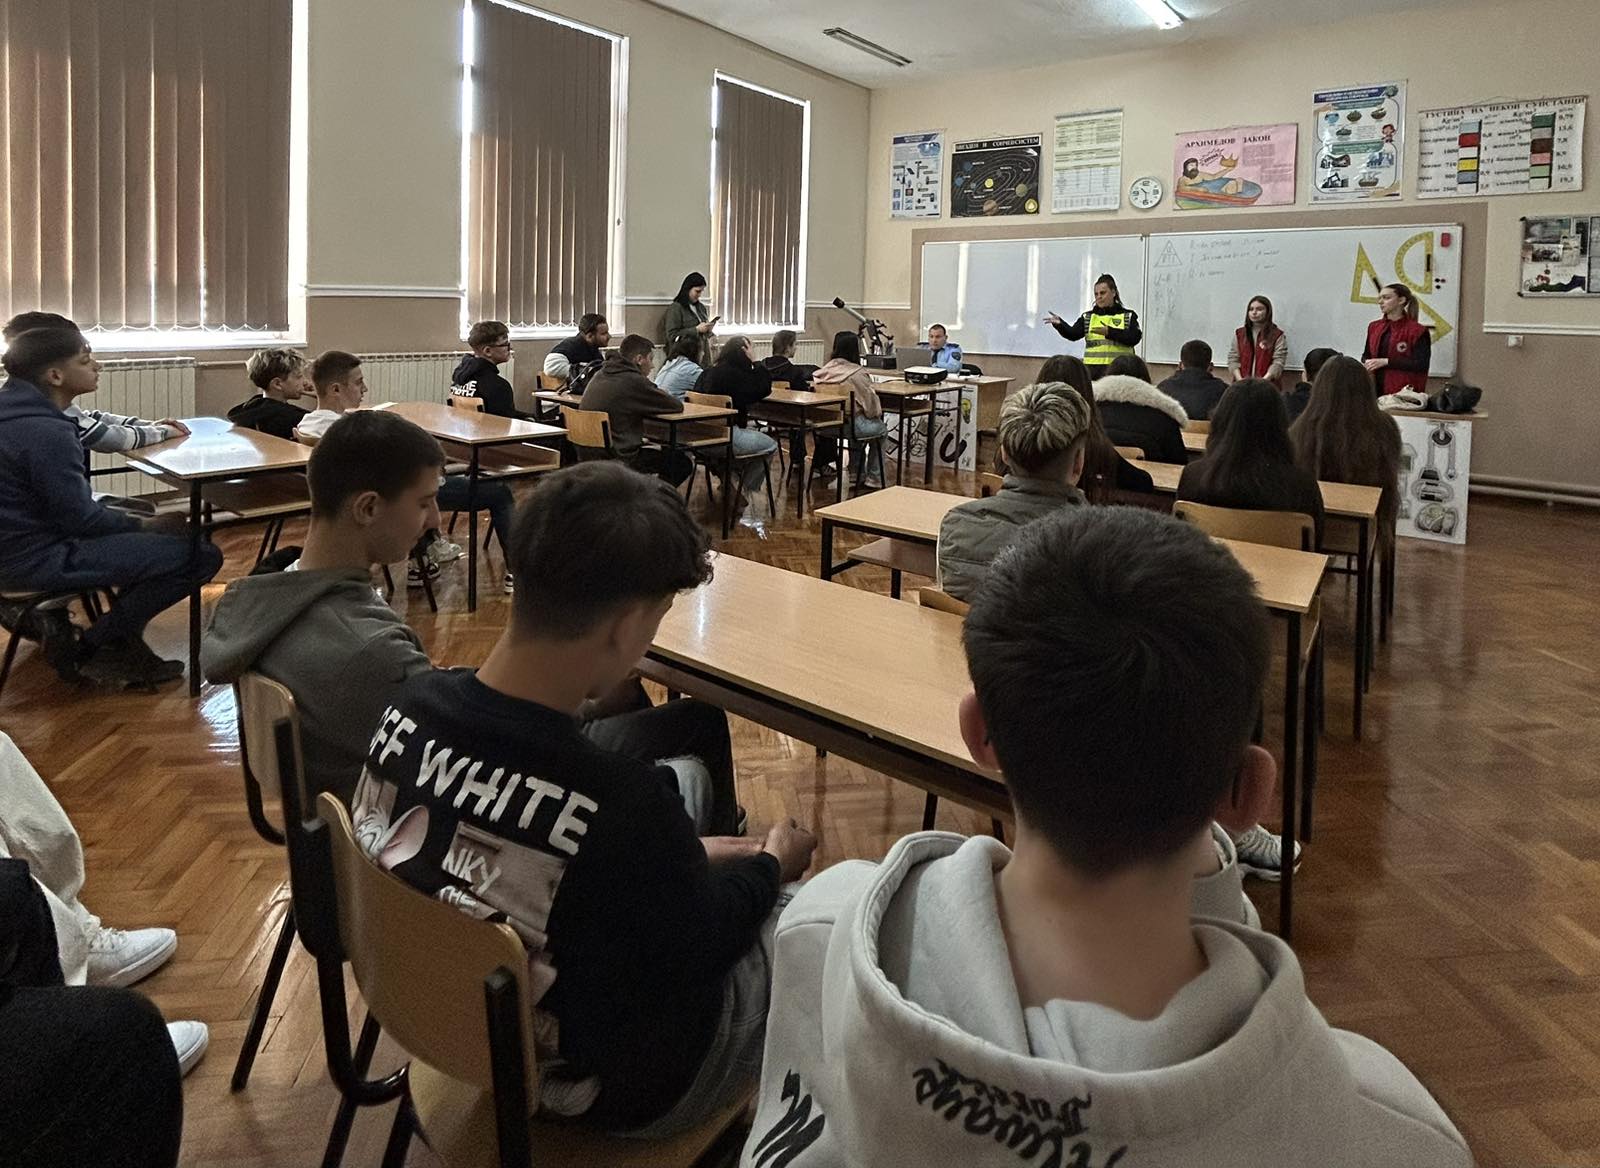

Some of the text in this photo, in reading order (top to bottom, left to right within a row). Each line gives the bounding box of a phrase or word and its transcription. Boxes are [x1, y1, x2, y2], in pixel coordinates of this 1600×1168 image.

[1426, 109, 1465, 119] ГУСТИНА
[1185, 135, 1272, 148] АРХИМЕДОВ ЗАКОН
[415, 739, 599, 856] WHITE
